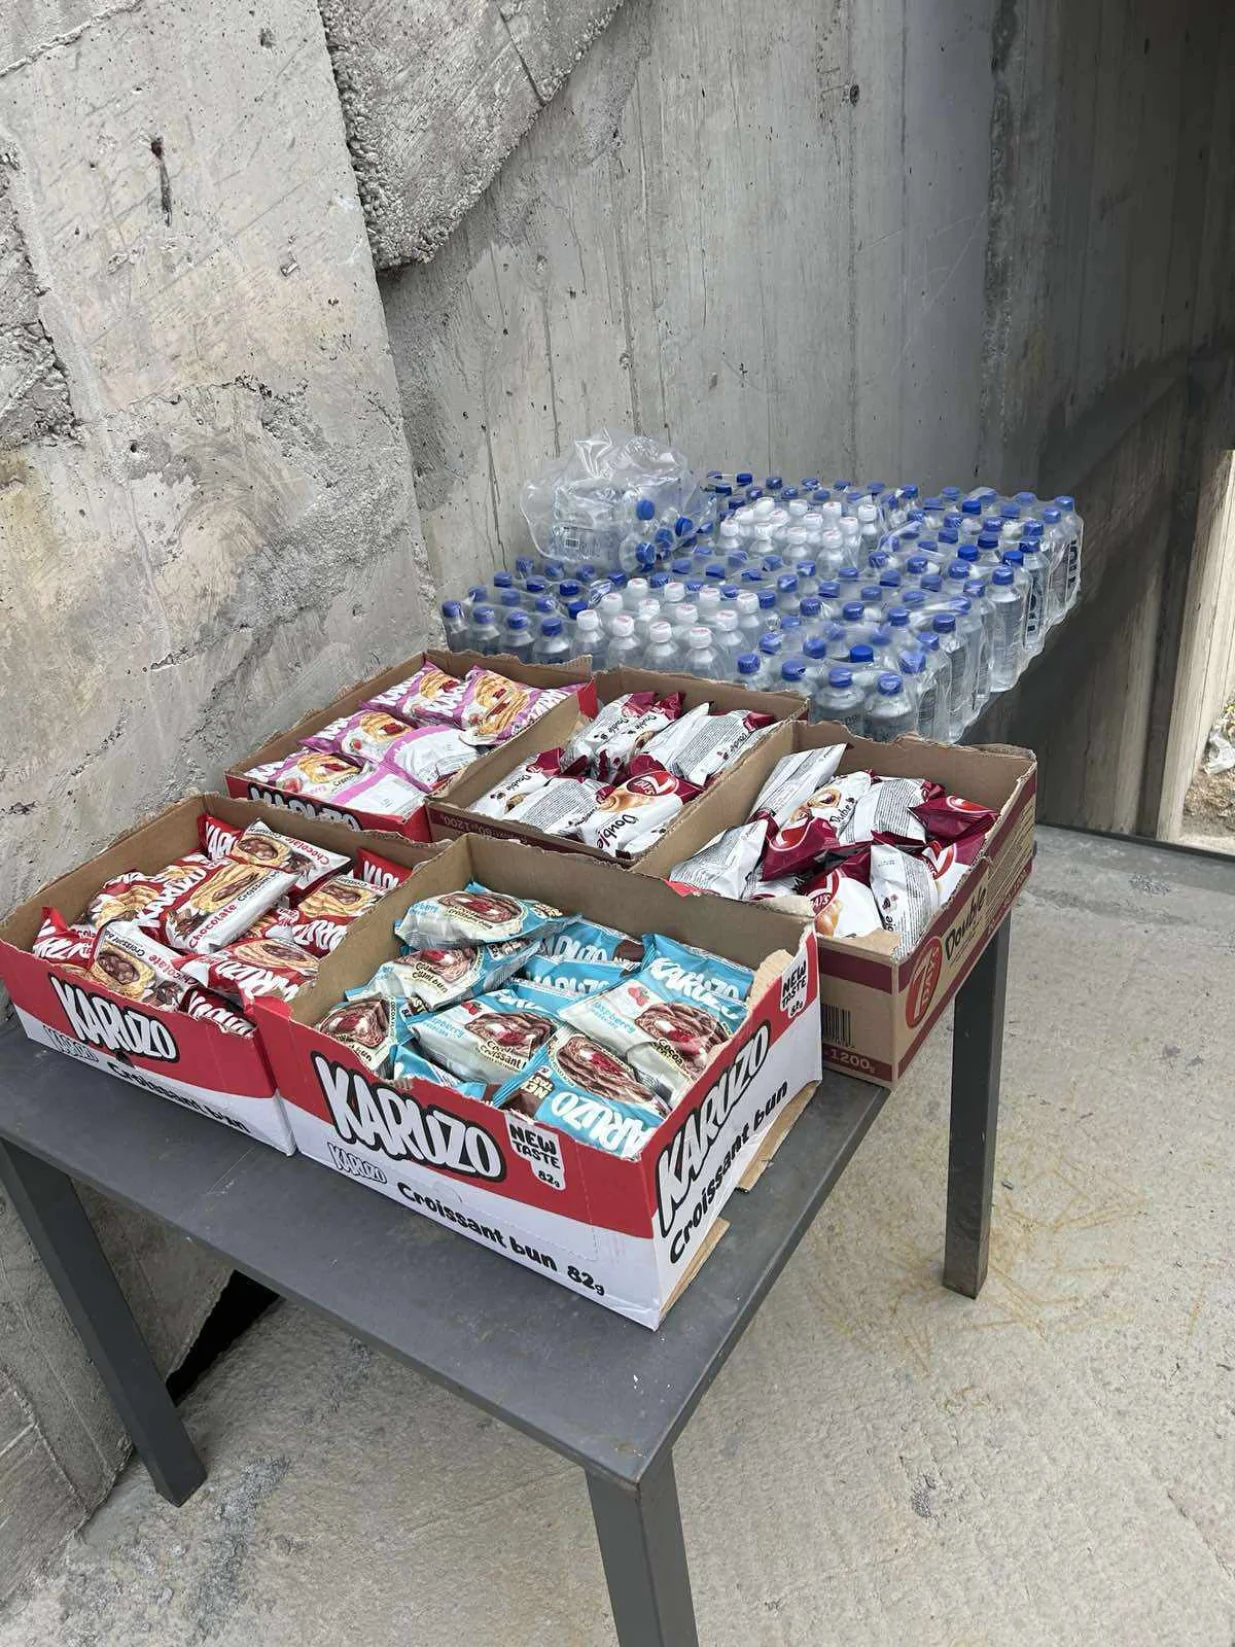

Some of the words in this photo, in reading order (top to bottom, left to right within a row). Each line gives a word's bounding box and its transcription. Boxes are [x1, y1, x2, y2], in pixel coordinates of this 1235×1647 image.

[597, 813, 639, 849] Double
[188, 903, 238, 949] Chocolate
[781, 959, 807, 998] NEW
[781, 974, 807, 1009] TASTE
[49, 973, 181, 1063] KARUZO
[658, 1038, 684, 1065] Cocoa
[311, 1050, 506, 1183] KARUZO
[550, 1090, 656, 1162] ARUZO
[655, 1018, 771, 1239] KARUZO
[509, 1125, 557, 1156] NEW
[512, 1141, 561, 1170] TASTE
[327, 1141, 388, 1185] KARUZO
[537, 1170, 561, 1188] 82g
[669, 1128, 751, 1264] Croissant
[753, 1079, 789, 1128] bun
[397, 1181, 508, 1250] Croissant
[509, 1235, 558, 1272] bun
[566, 1264, 606, 1297] 82g
